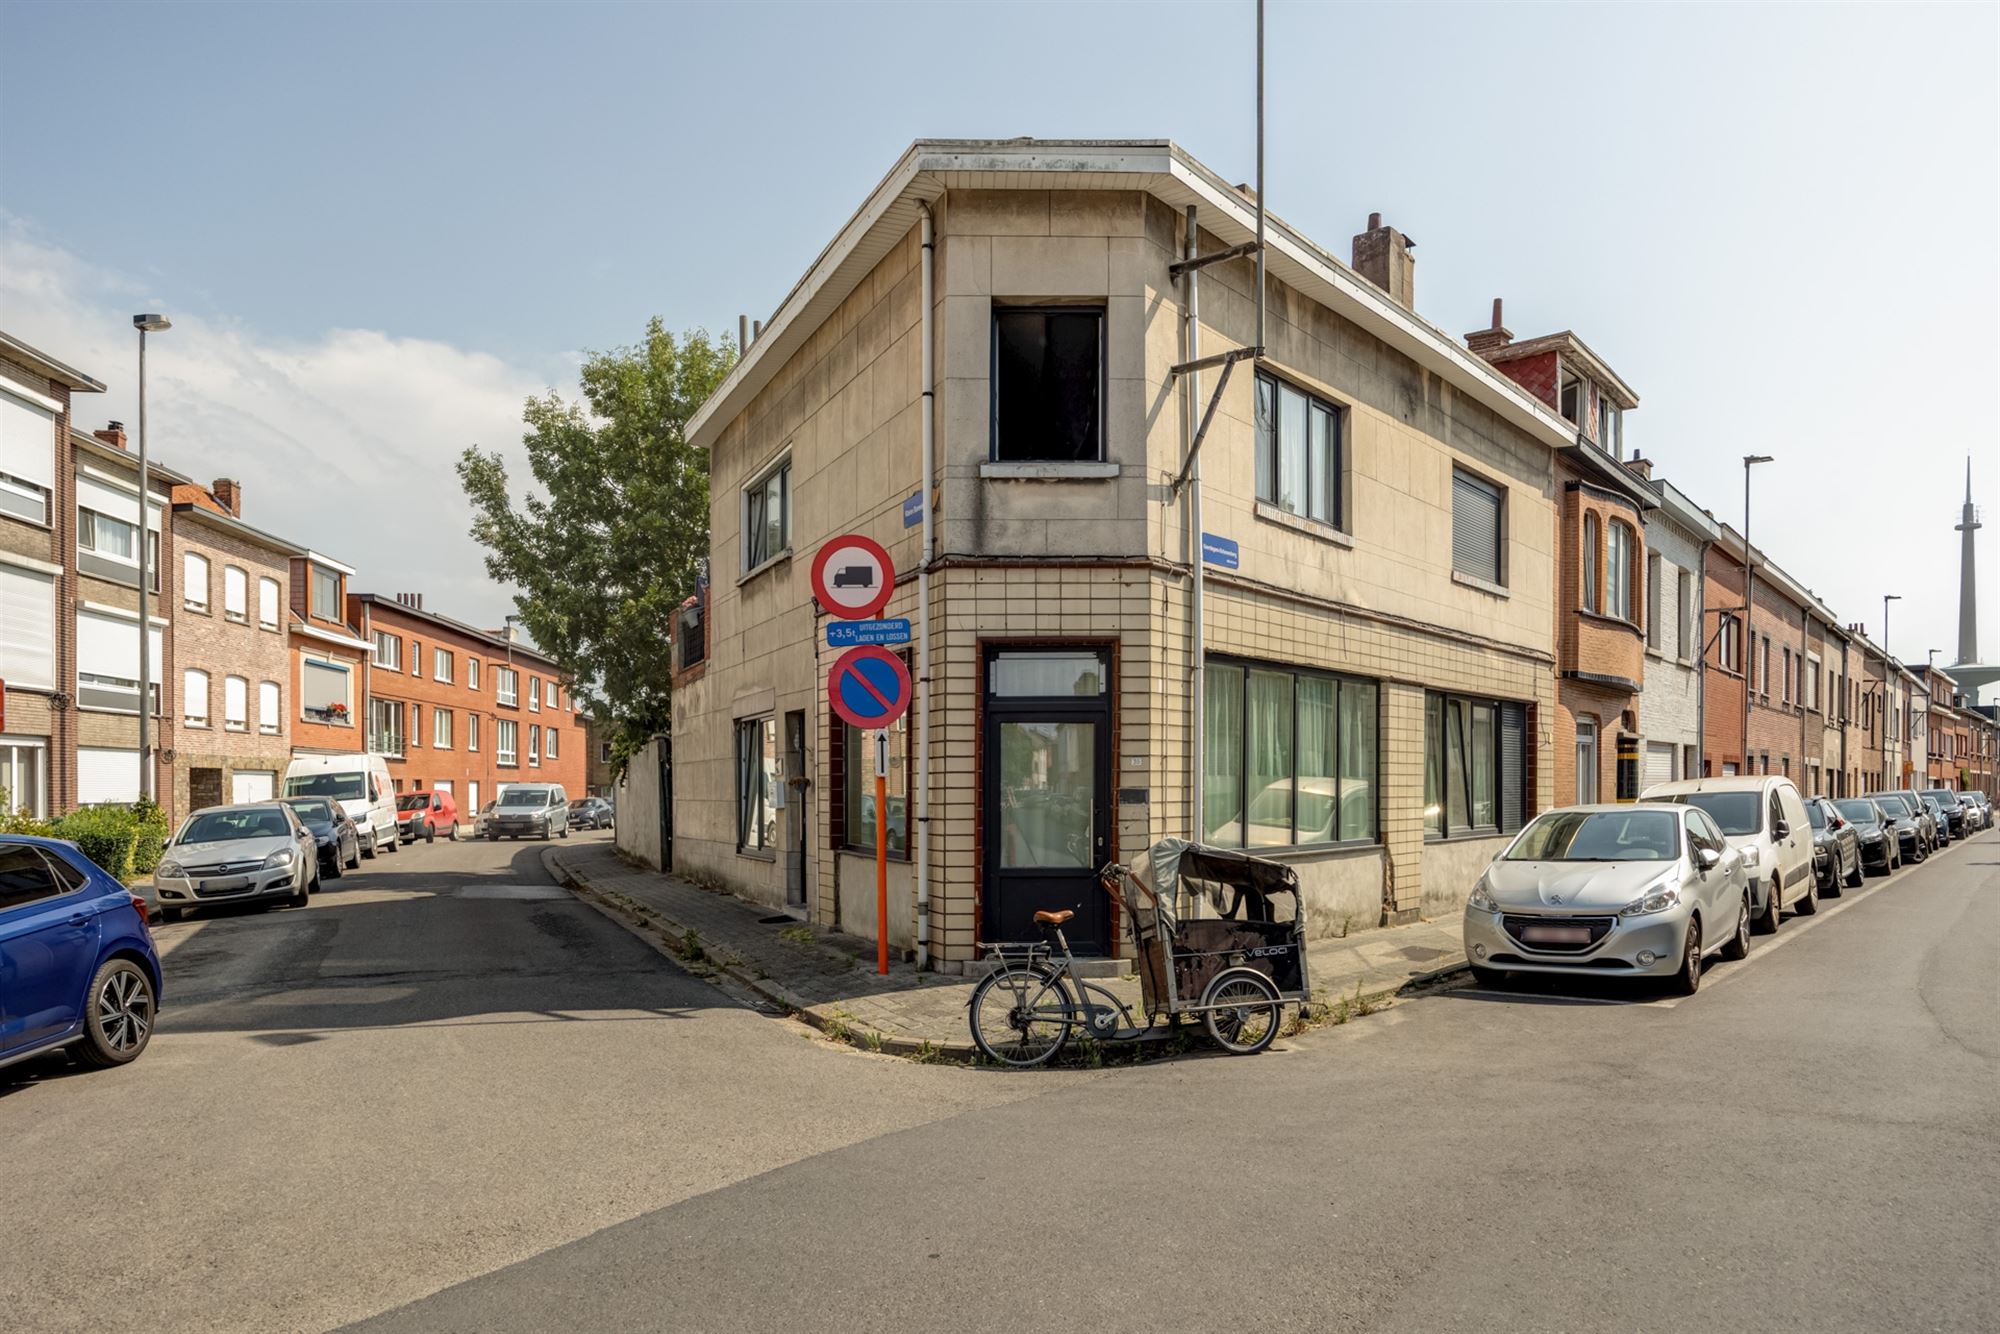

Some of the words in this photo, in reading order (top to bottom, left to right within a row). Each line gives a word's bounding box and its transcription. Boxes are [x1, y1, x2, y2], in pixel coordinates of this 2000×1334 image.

[859, 622, 903, 631] UITGEZONDERD
[829, 628, 856, 639] +3,5t
[856, 633, 874, 642] LADEN
[876, 633, 885, 641] EN
[886, 632, 908, 641] LOSSEN
